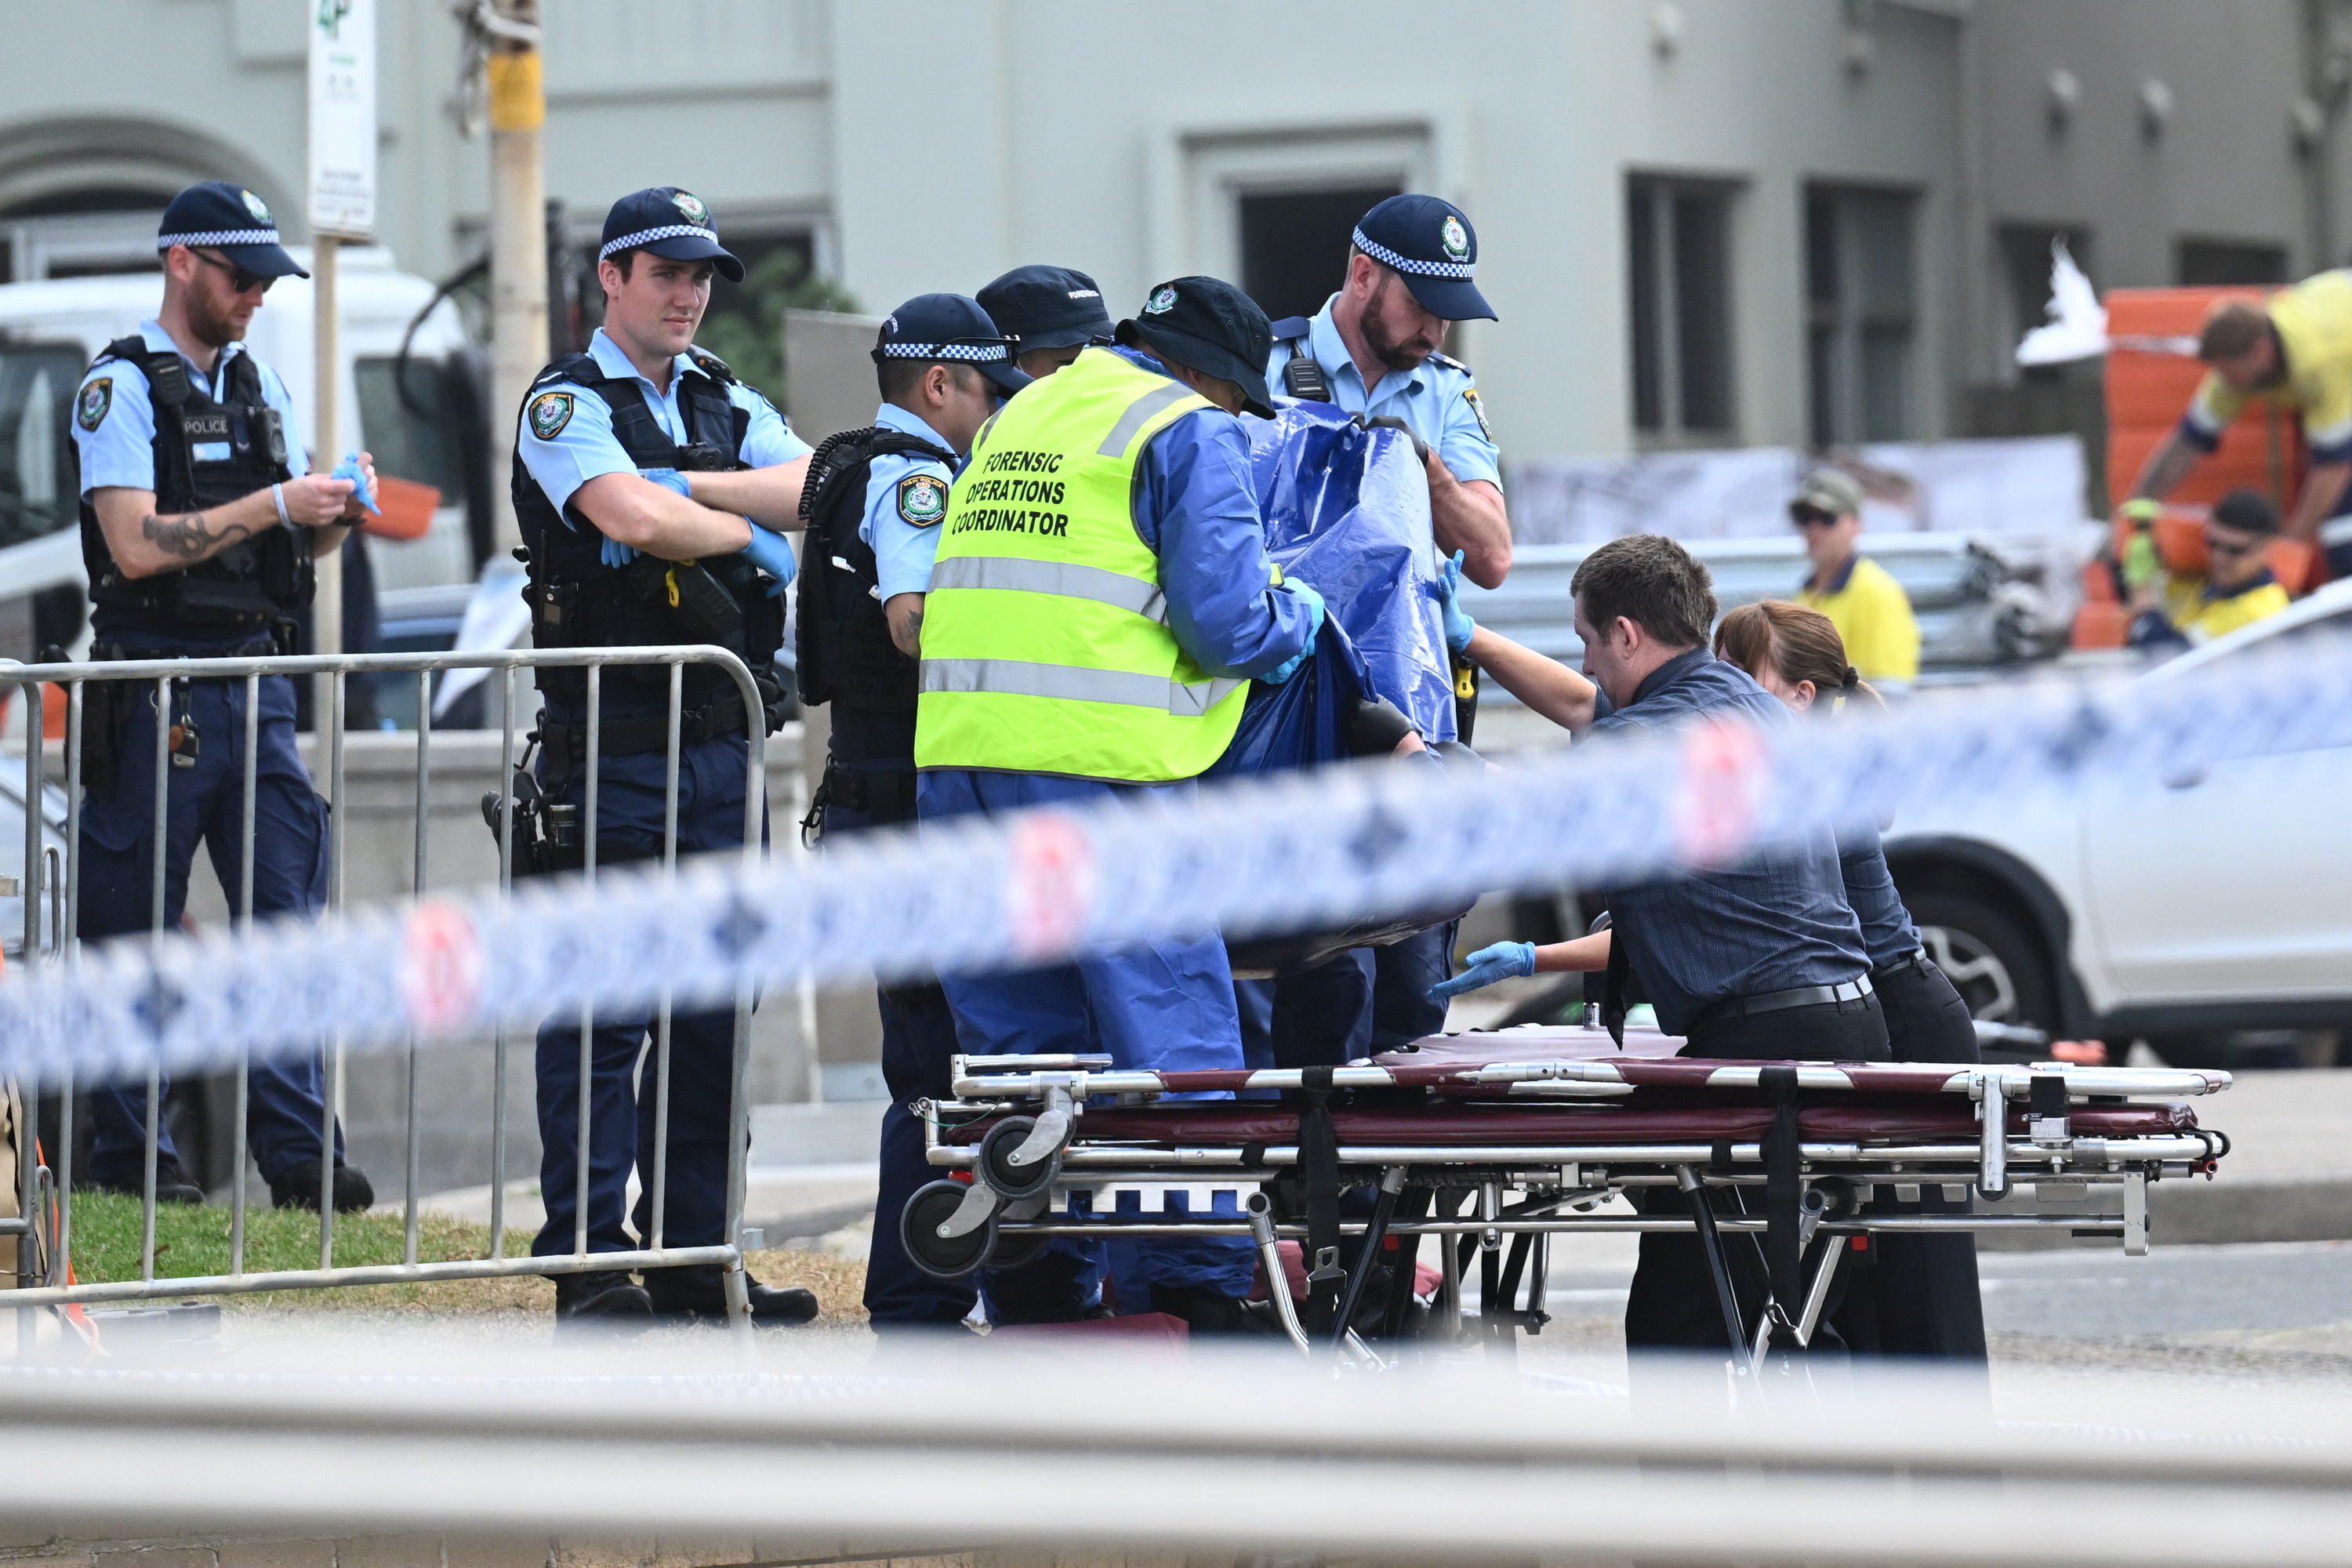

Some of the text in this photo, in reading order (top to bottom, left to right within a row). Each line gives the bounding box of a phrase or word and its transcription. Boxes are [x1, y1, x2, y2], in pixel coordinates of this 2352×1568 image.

[184, 419, 228, 434] POLICE
[982, 451, 1064, 474] FORENSIC
[920, 477, 942, 488] POLICE
[966, 480, 1065, 504] OPERATIONS
[952, 509, 1069, 537] COORDINATOR
